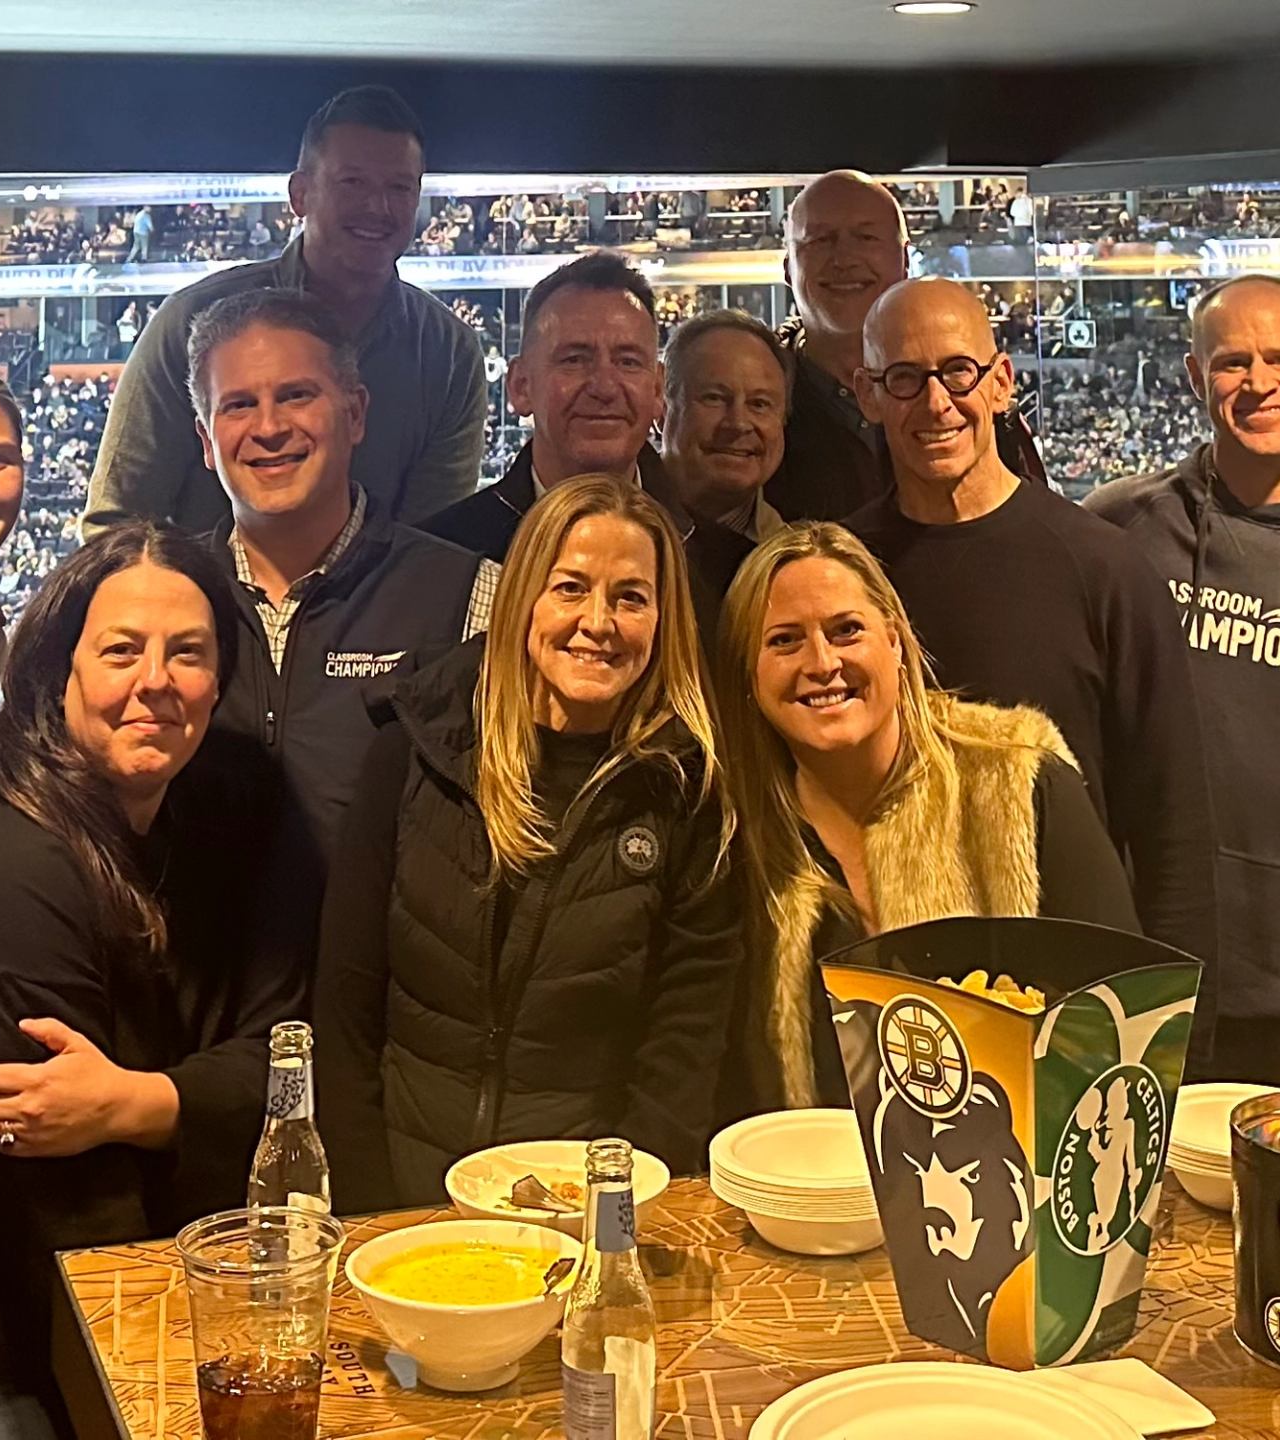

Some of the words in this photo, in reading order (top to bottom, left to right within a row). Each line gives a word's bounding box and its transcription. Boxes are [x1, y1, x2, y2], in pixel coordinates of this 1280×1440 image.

[1168, 579, 1263, 620] SROOM
[325, 661, 398, 678] CHAMPION
[327, 651, 374, 662] CLASSROOM
[901, 1020, 945, 1091] B
[1057, 1132, 1081, 1235] BOSTON
[1136, 1076, 1162, 1166] CELTICS
[329, 1341, 376, 1395] SOUTH
